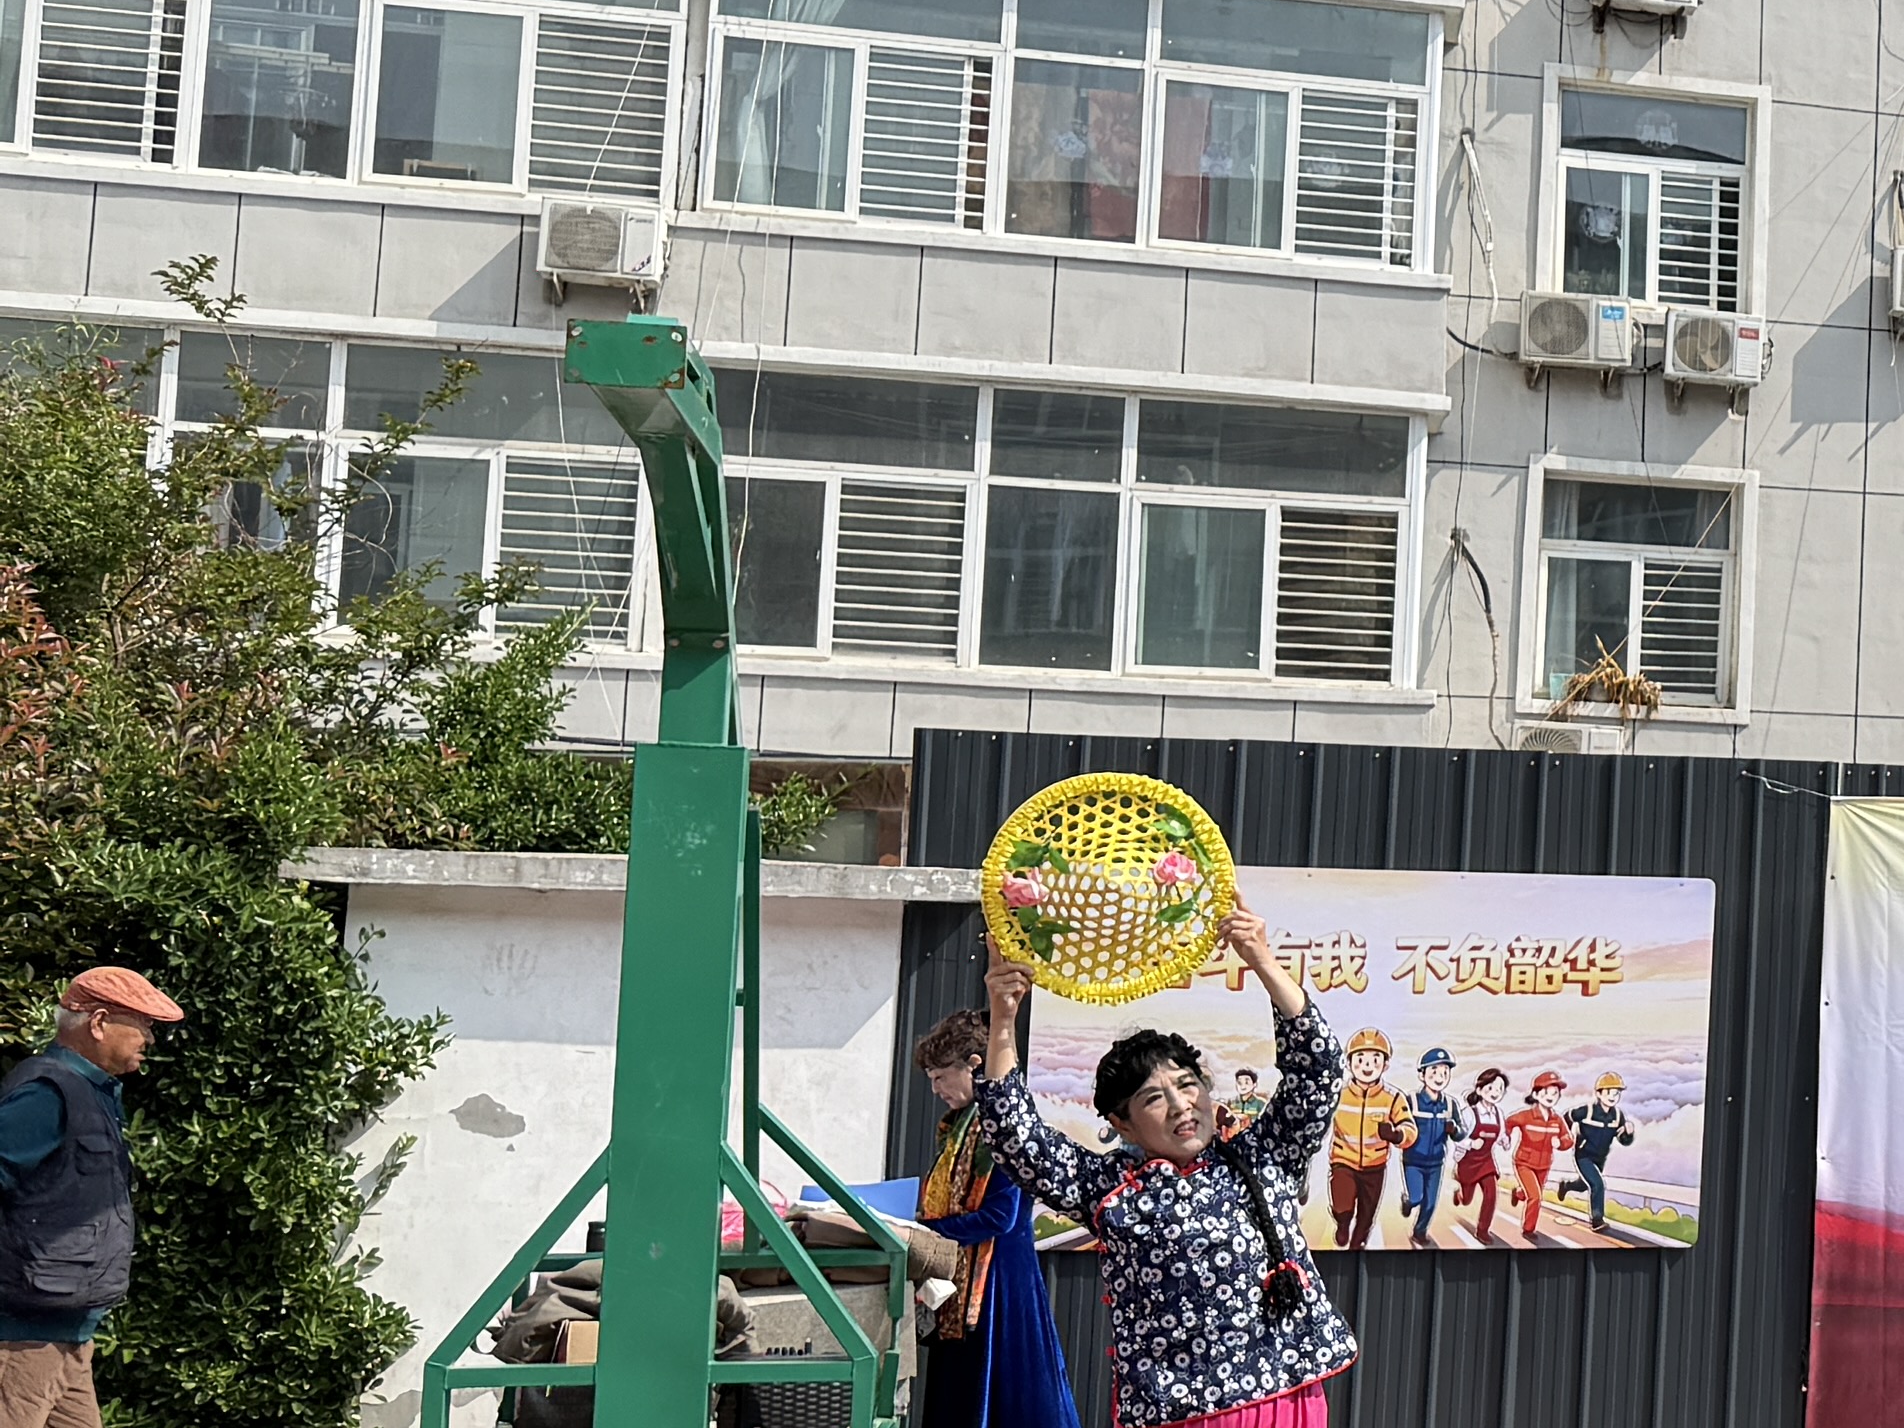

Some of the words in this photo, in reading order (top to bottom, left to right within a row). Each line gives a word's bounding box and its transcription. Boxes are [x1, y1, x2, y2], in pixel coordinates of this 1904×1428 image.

[1168, 928, 1369, 993] 斗有我
[1392, 932, 1624, 996] 不负韶华
